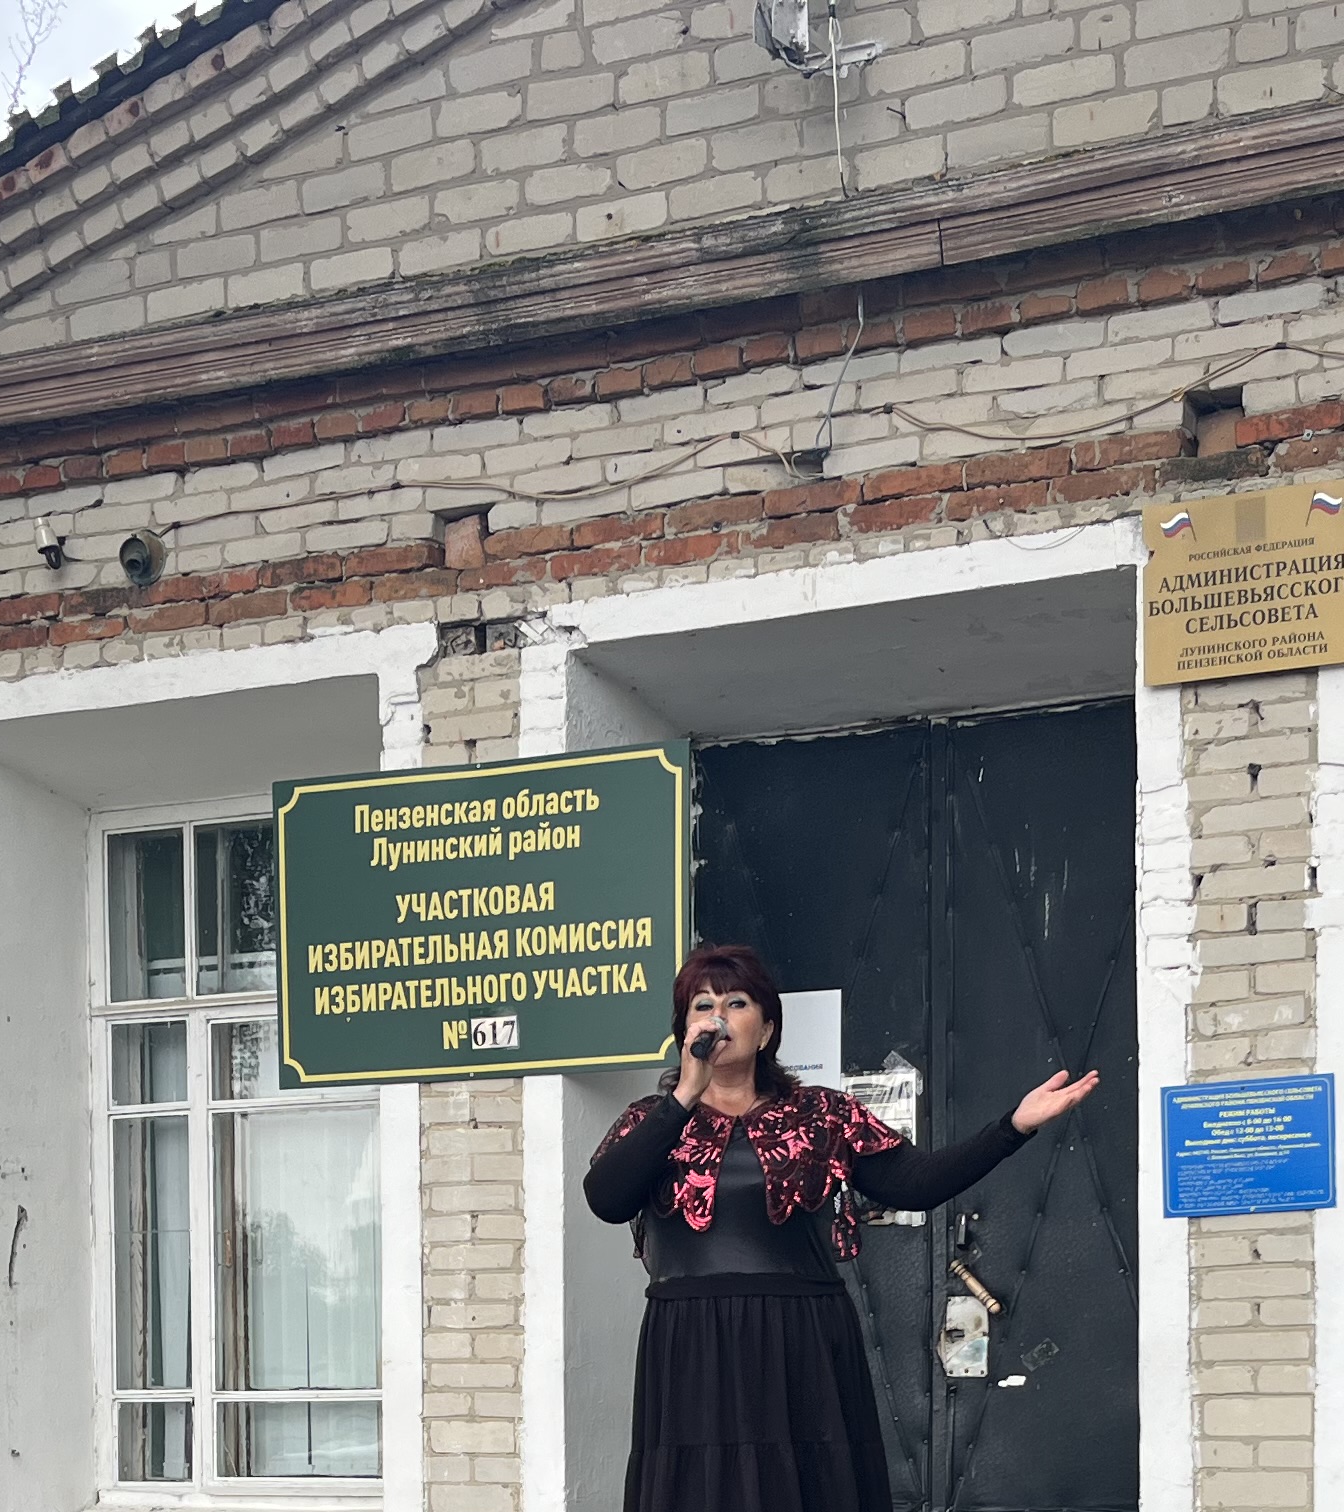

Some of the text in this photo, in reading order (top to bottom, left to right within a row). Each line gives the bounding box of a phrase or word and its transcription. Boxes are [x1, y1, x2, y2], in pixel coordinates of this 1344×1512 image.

[1188, 537, 1315, 562] РОССИЙСКАЯ ФЕДЕРАЦИЯ
[1185, 603, 1319, 635] СЕЛЬСОВЕТА
[1177, 643, 1328, 671] ПЕНЗЕНСКОЙ ОБЛАСТИ
[1180, 631, 1325, 658] ЛУНИНСКОГО РАЙОНА
[354, 788, 600, 834] Пензенская область
[370, 822, 581, 871] Лунинский район
[395, 881, 555, 923] УЧАСТКОВАЯ
[308, 917, 653, 974] ИЗБИРАТЕЛЬНАЯ КОМИССИЯ
[314, 962, 647, 1016] ИЗБИРАТЕЛЬНОГО УЧАСТКА
[473, 1019, 516, 1048] 617
